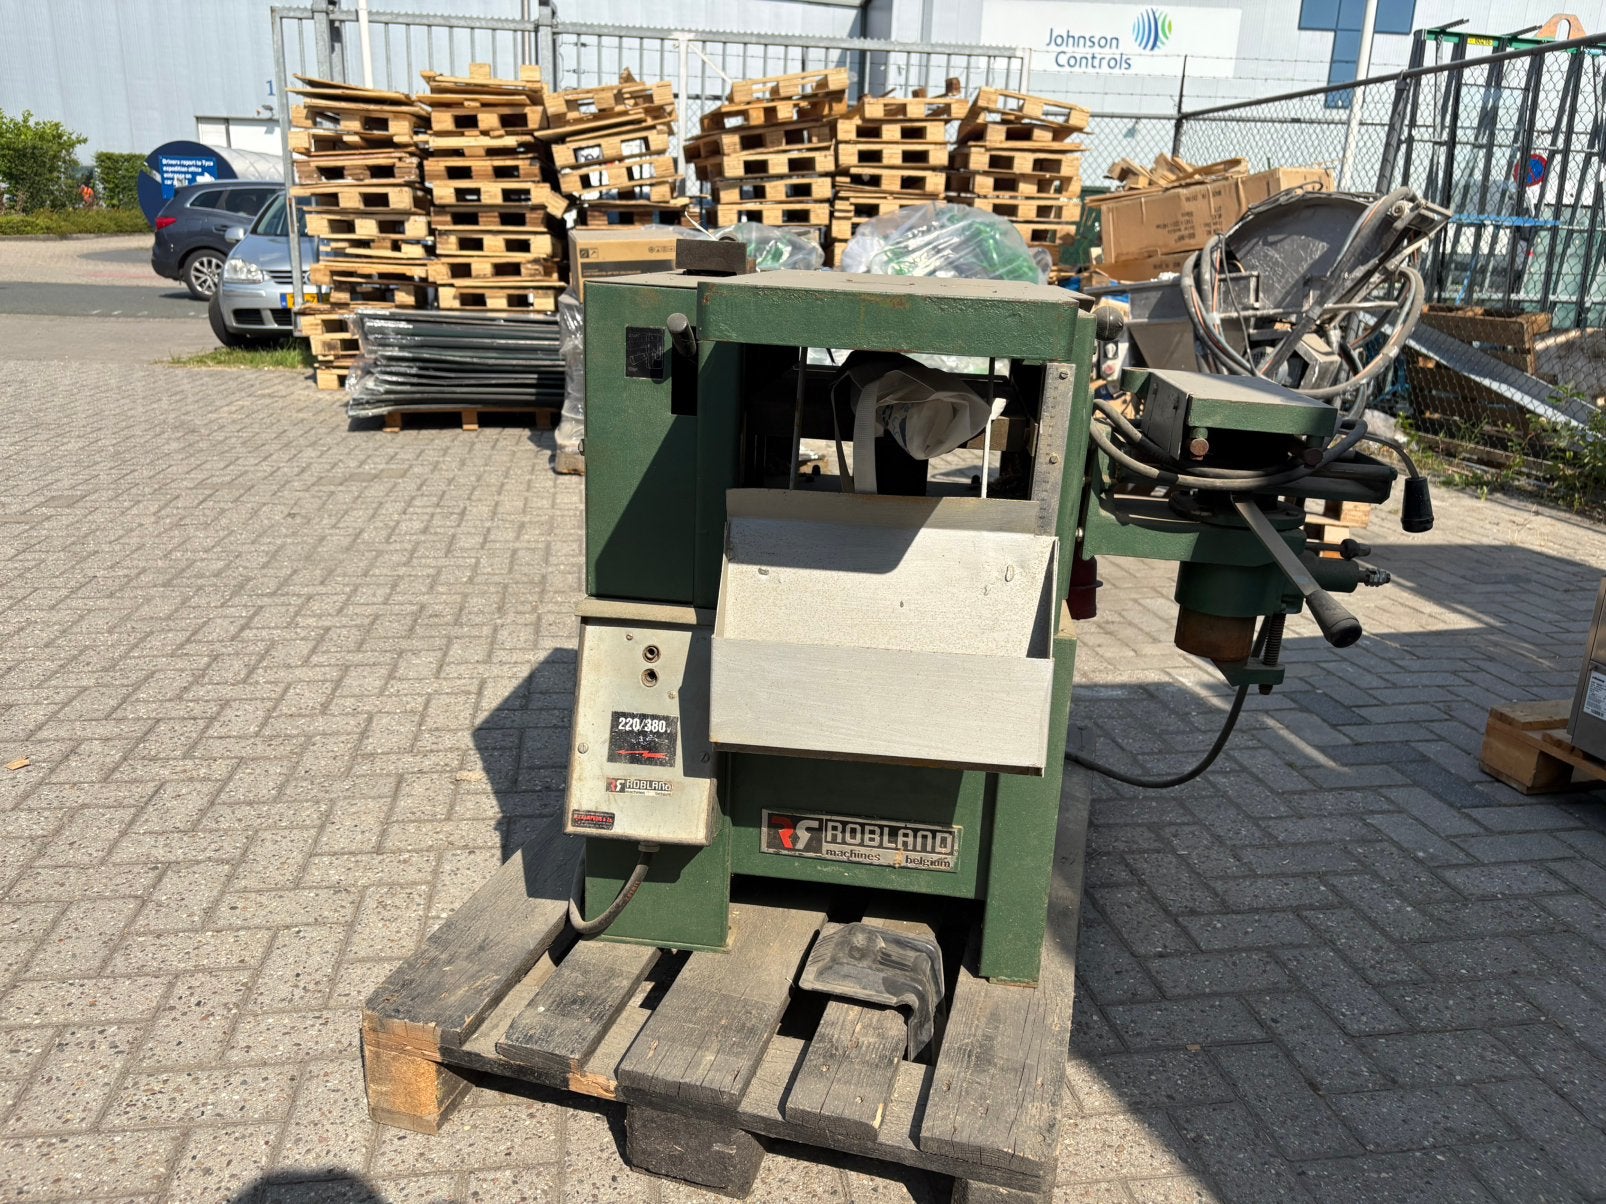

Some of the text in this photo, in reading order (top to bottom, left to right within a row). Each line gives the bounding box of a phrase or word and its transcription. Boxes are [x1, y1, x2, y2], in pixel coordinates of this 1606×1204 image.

[1046, 27, 1120, 49] Johnson
[1055, 51, 1132, 70] Controls
[181, 159, 196, 167] report
[826, 820, 953, 854] ROBLAND
[825, 848, 951, 869] machines belgium
